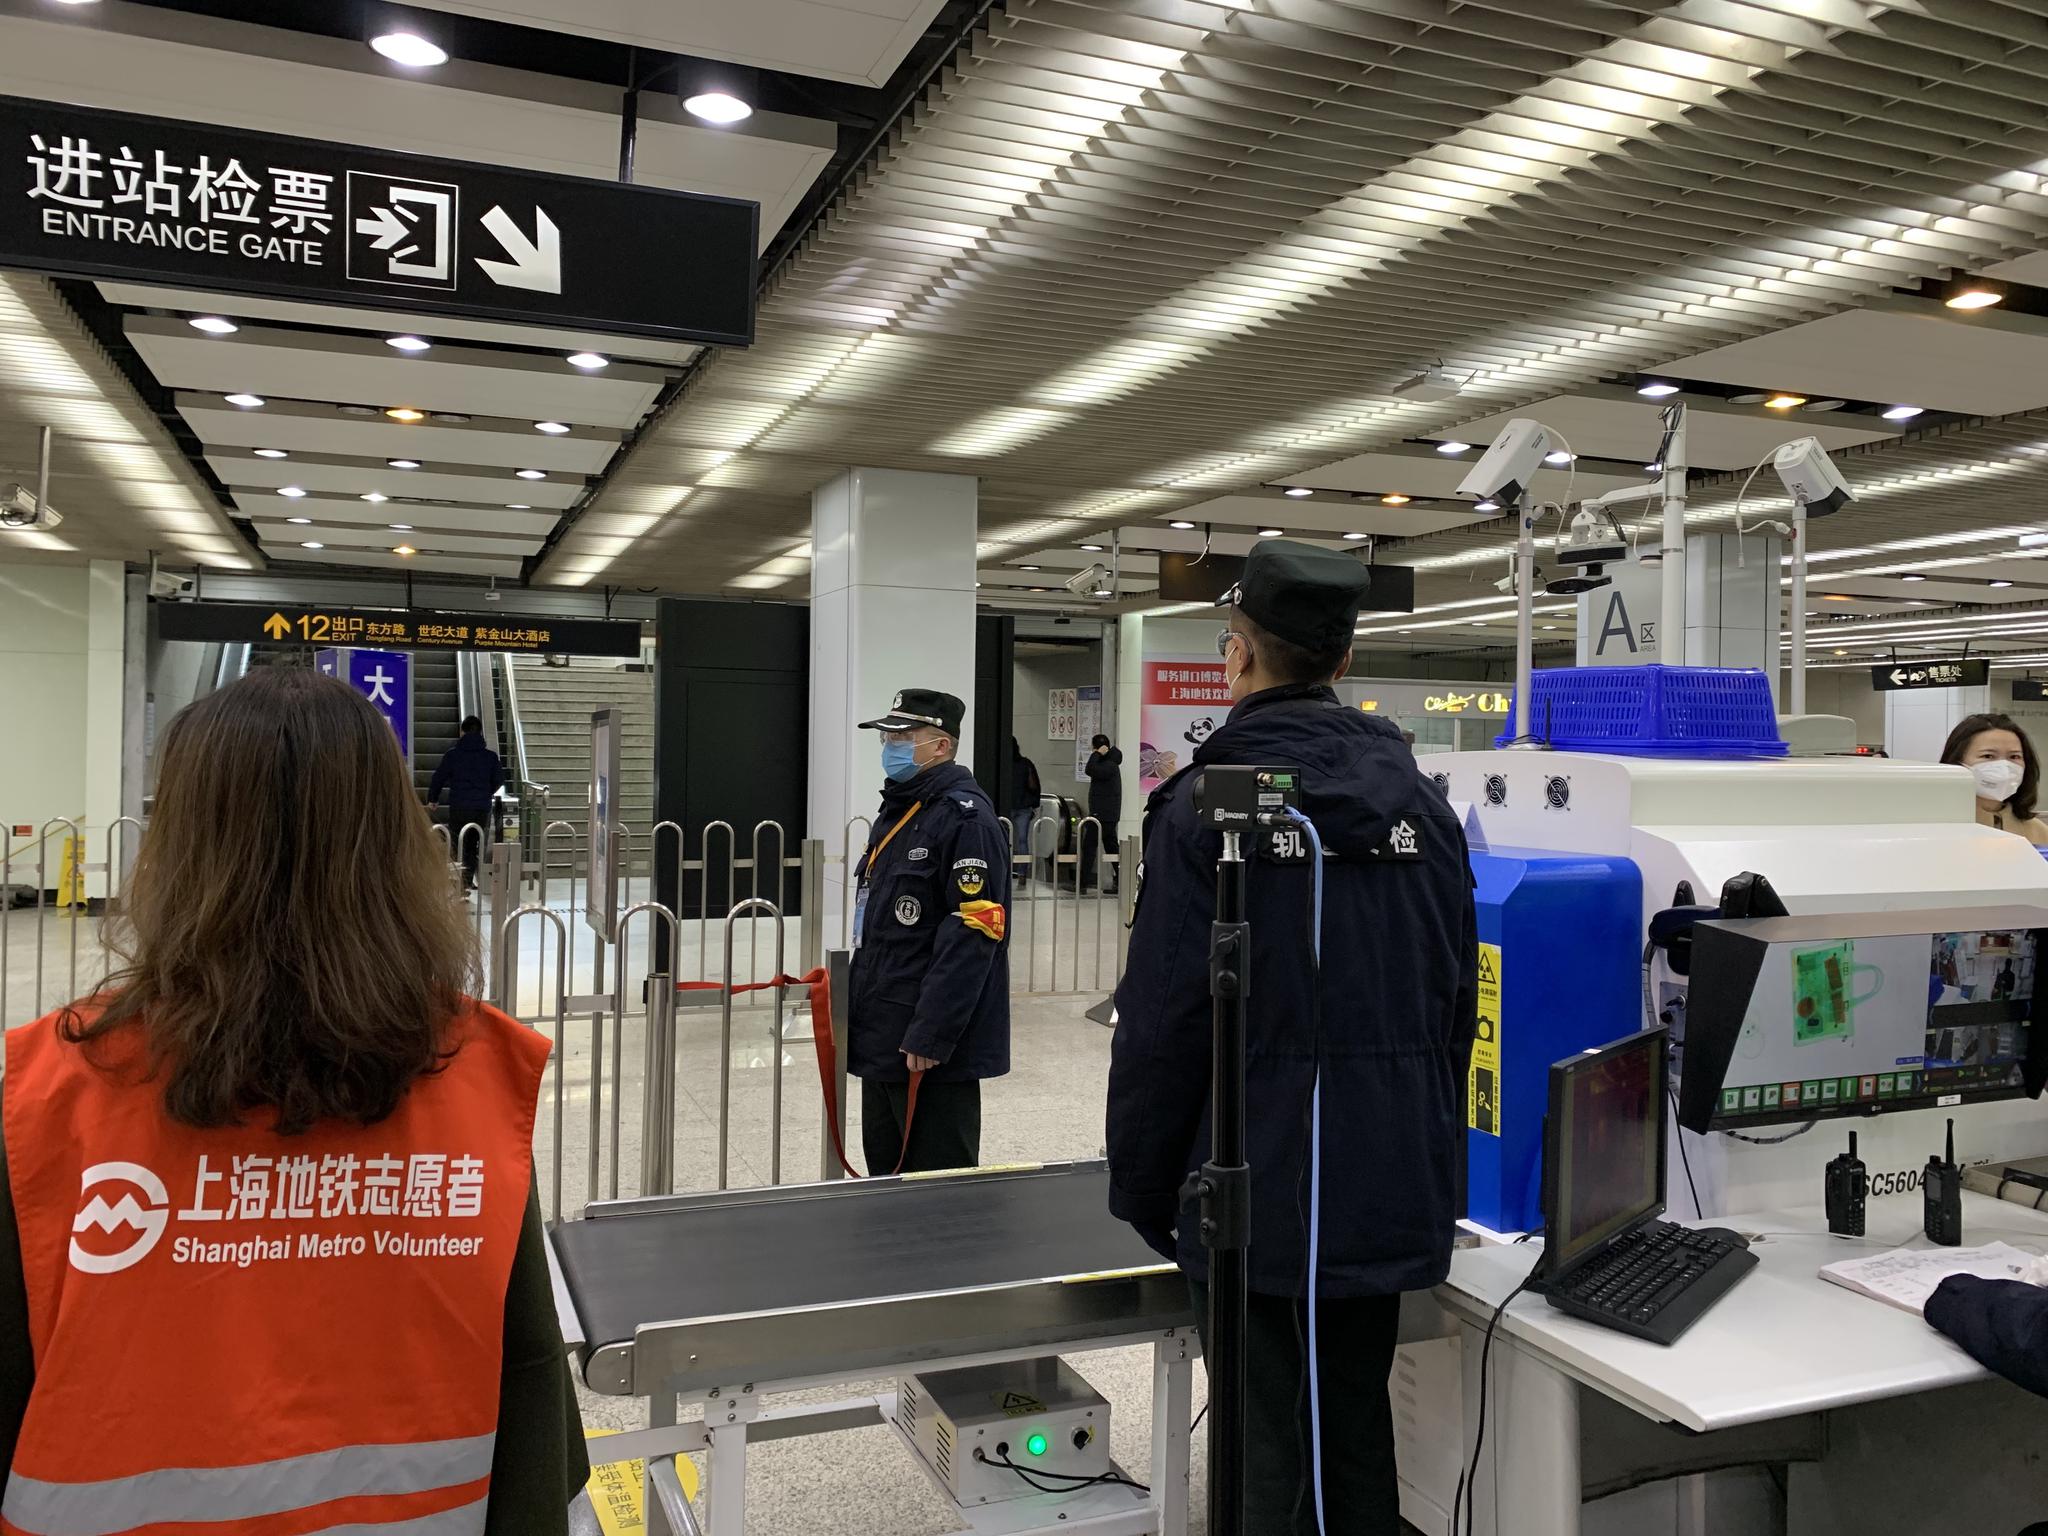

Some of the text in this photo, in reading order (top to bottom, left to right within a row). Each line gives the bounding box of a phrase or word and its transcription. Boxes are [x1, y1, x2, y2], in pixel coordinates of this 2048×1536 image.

[26, 133, 337, 236] 进站检票
[42, 208, 324, 267] ENTRANCE GATE
[297, 614, 551, 643] 12 出口 东方路 世纪大道 紫金山大酒店
[332, 632, 357, 642] EXIT
[1595, 590, 1638, 656] A
[1641, 622, 1656, 643] 区
[1928, 665, 1963, 679] 售票处
[1272, 820, 1419, 859] 轨检
[955, 859, 986, 868] ANJIAN
[961, 873, 980, 883] 安检
[177, 1153, 484, 1221] 上海地铁志愿者
[172, 1230, 484, 1268] Shanghai Metro Volunteer
